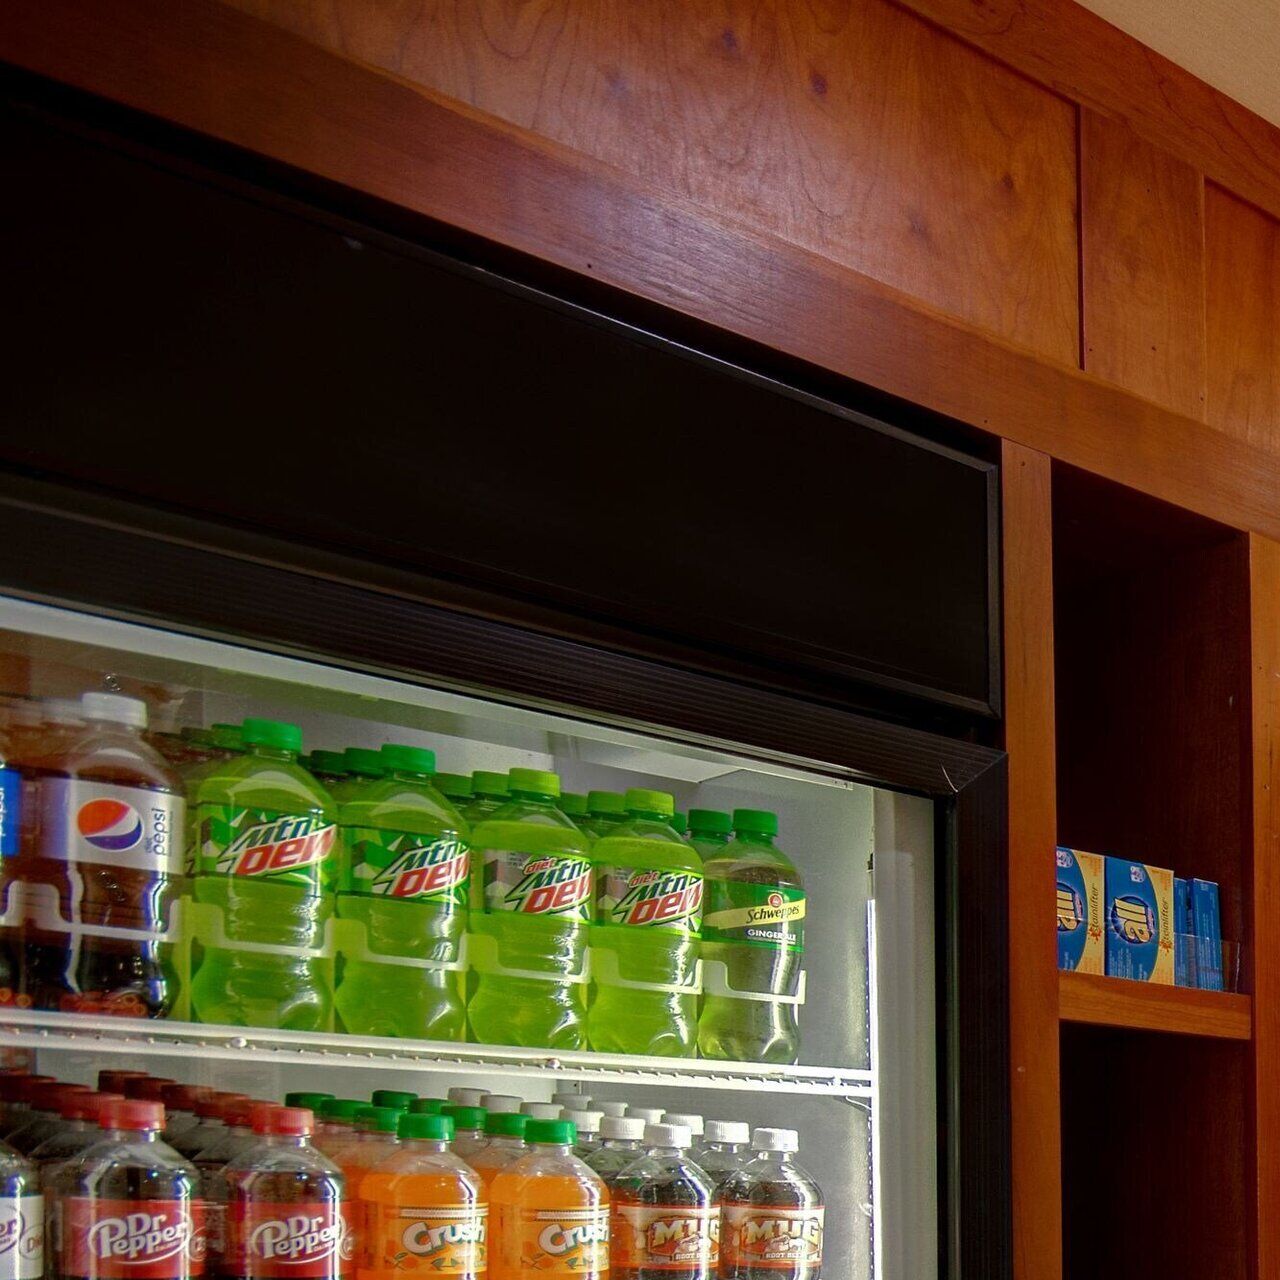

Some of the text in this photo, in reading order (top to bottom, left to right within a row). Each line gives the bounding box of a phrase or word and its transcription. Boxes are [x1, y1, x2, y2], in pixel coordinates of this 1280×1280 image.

[151, 807, 166, 855] pepsi
[524, 857, 556, 874] diet
[629, 871, 660, 887] diet
[745, 904, 800, 924] Schweppes
[1115, 898, 1152, 944] all
[746, 928, 781, 940] GINGER
[125, 1213, 167, 1236] Dr
[288, 1215, 322, 1236] Dr
[746, 1218, 822, 1245] MUG
[99, 1219, 189, 1259] Pepper
[402, 1222, 486, 1256] Crush
[537, 1222, 610, 1256] Crush
